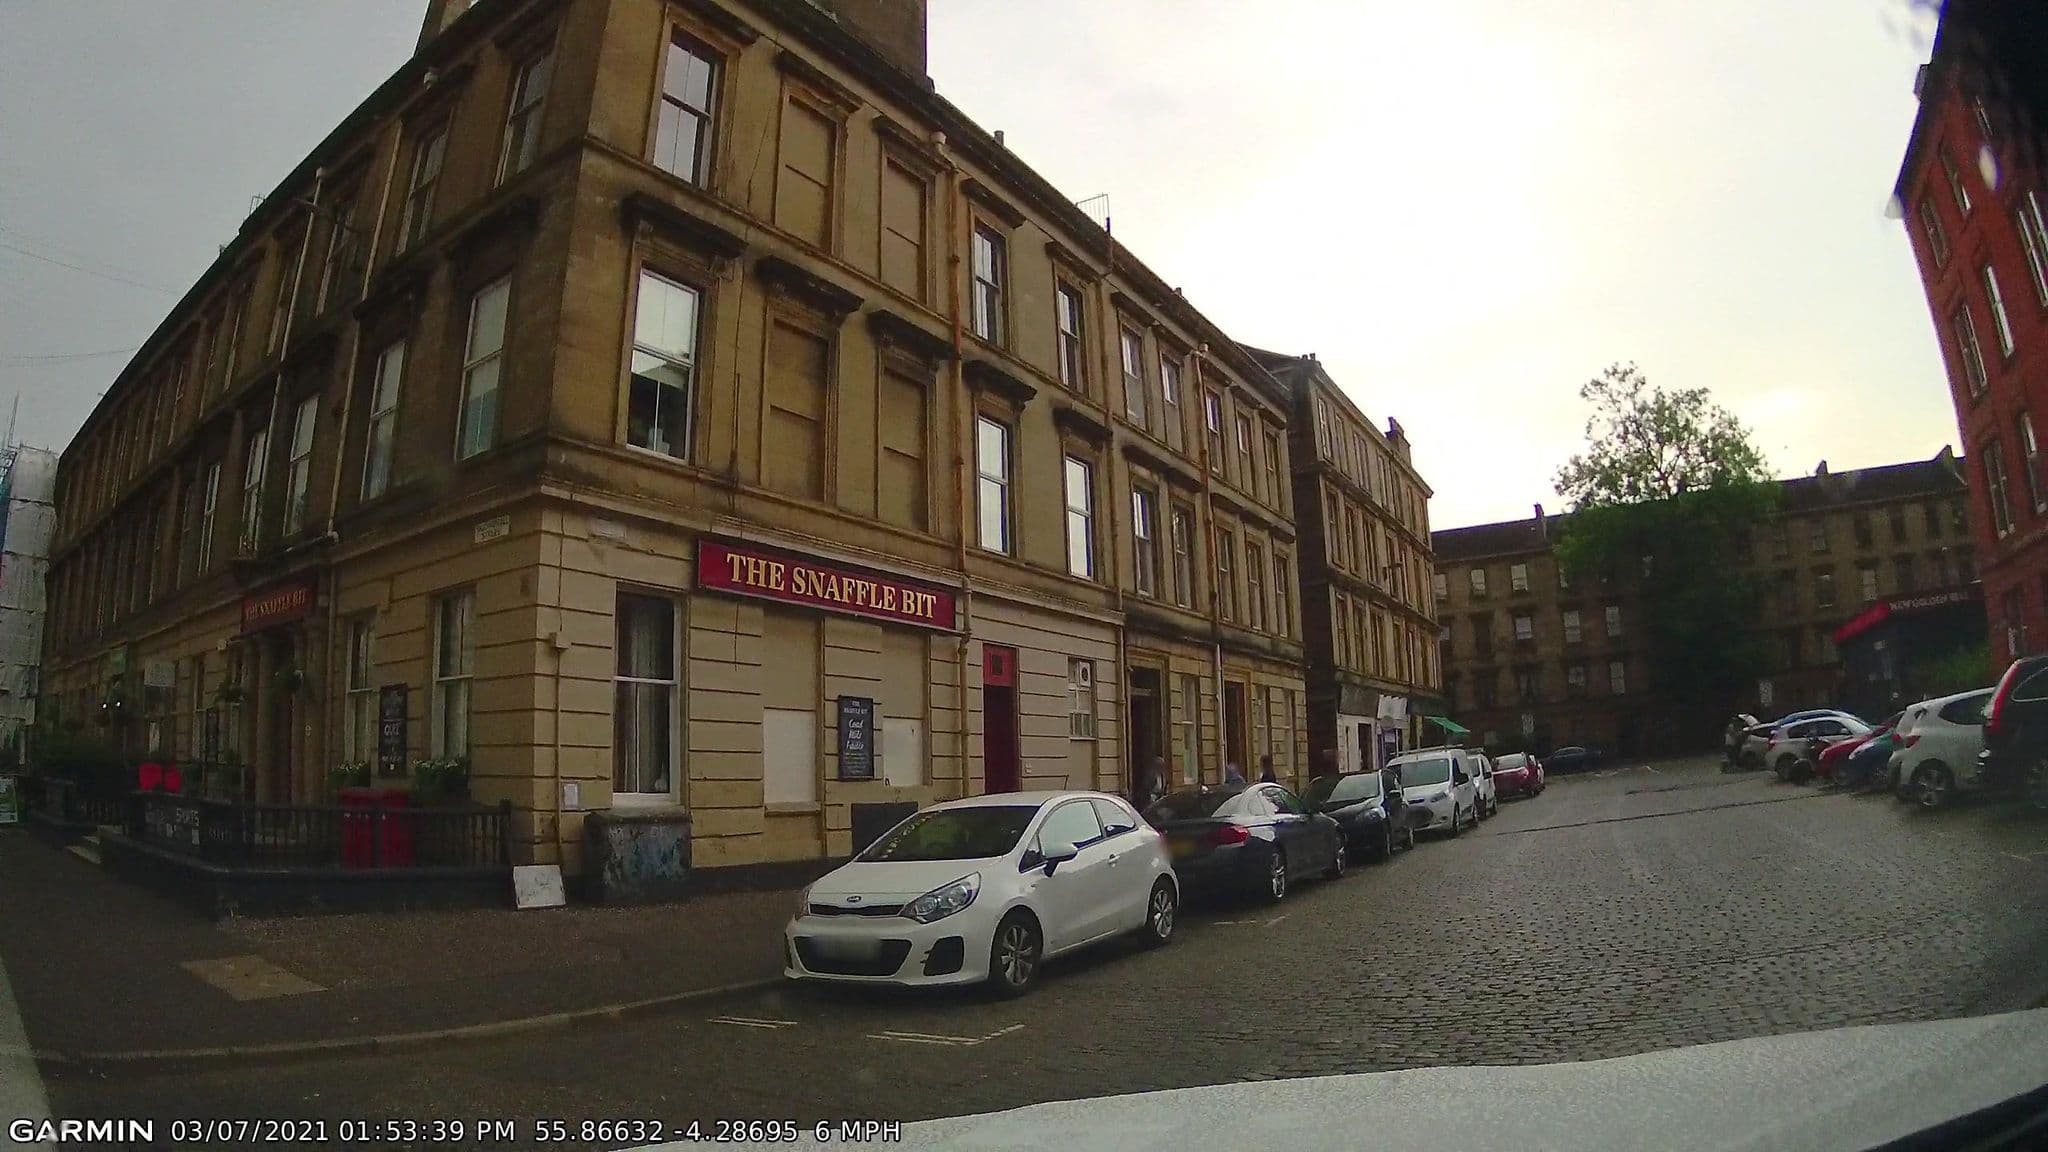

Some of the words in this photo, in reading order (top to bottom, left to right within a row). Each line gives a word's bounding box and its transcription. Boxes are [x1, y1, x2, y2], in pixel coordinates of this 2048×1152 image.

[727, 553, 785, 592] THE
[792, 566, 896, 611] SNAFFLE
[901, 589, 937, 618] BIT
